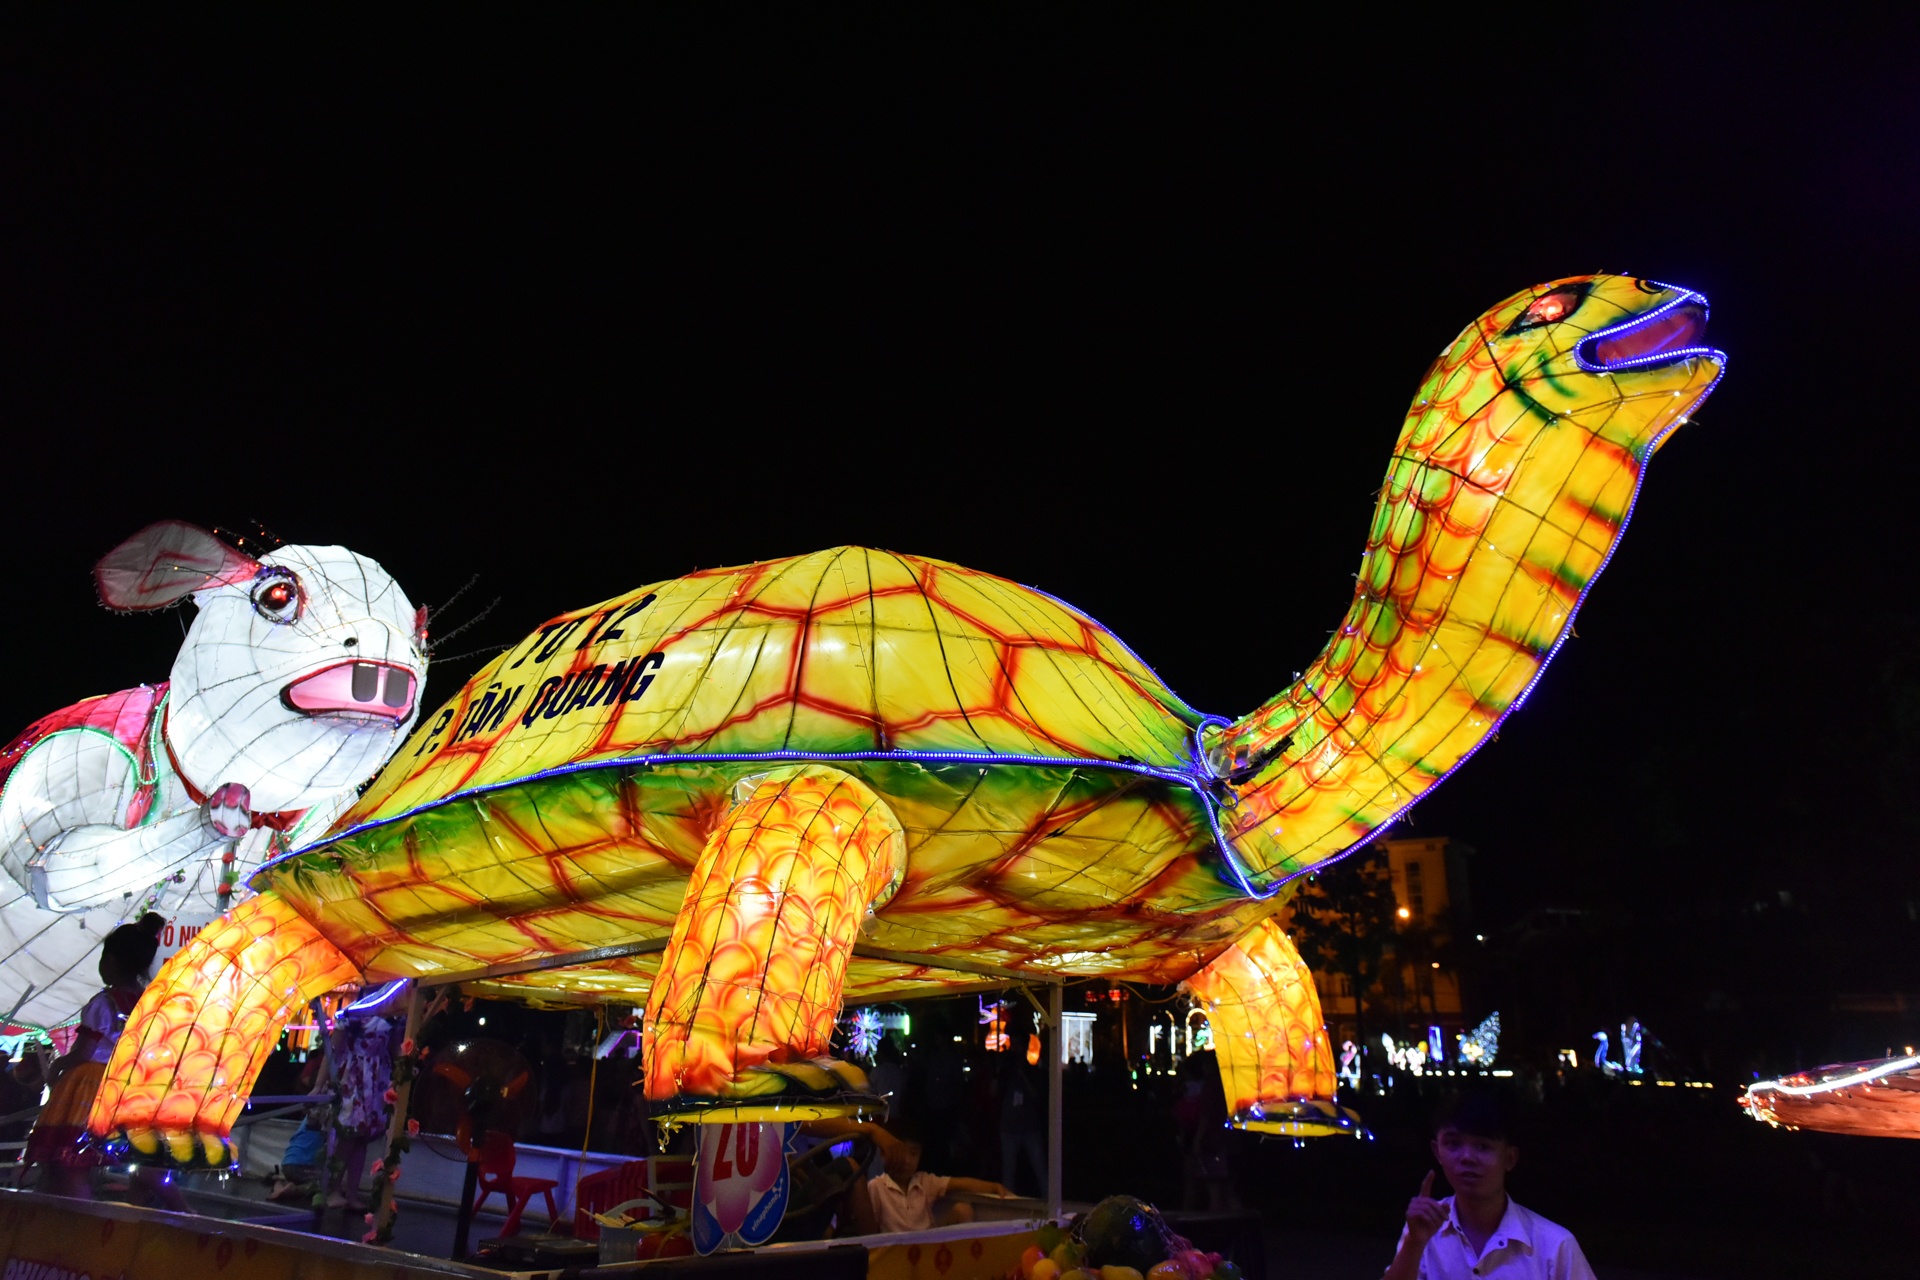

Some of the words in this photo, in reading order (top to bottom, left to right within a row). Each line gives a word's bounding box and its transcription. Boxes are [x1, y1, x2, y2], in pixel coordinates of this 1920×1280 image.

[575, 594, 658, 650] 12
[448, 682, 524, 747] TÂN
[522, 652, 664, 729] QUANG
